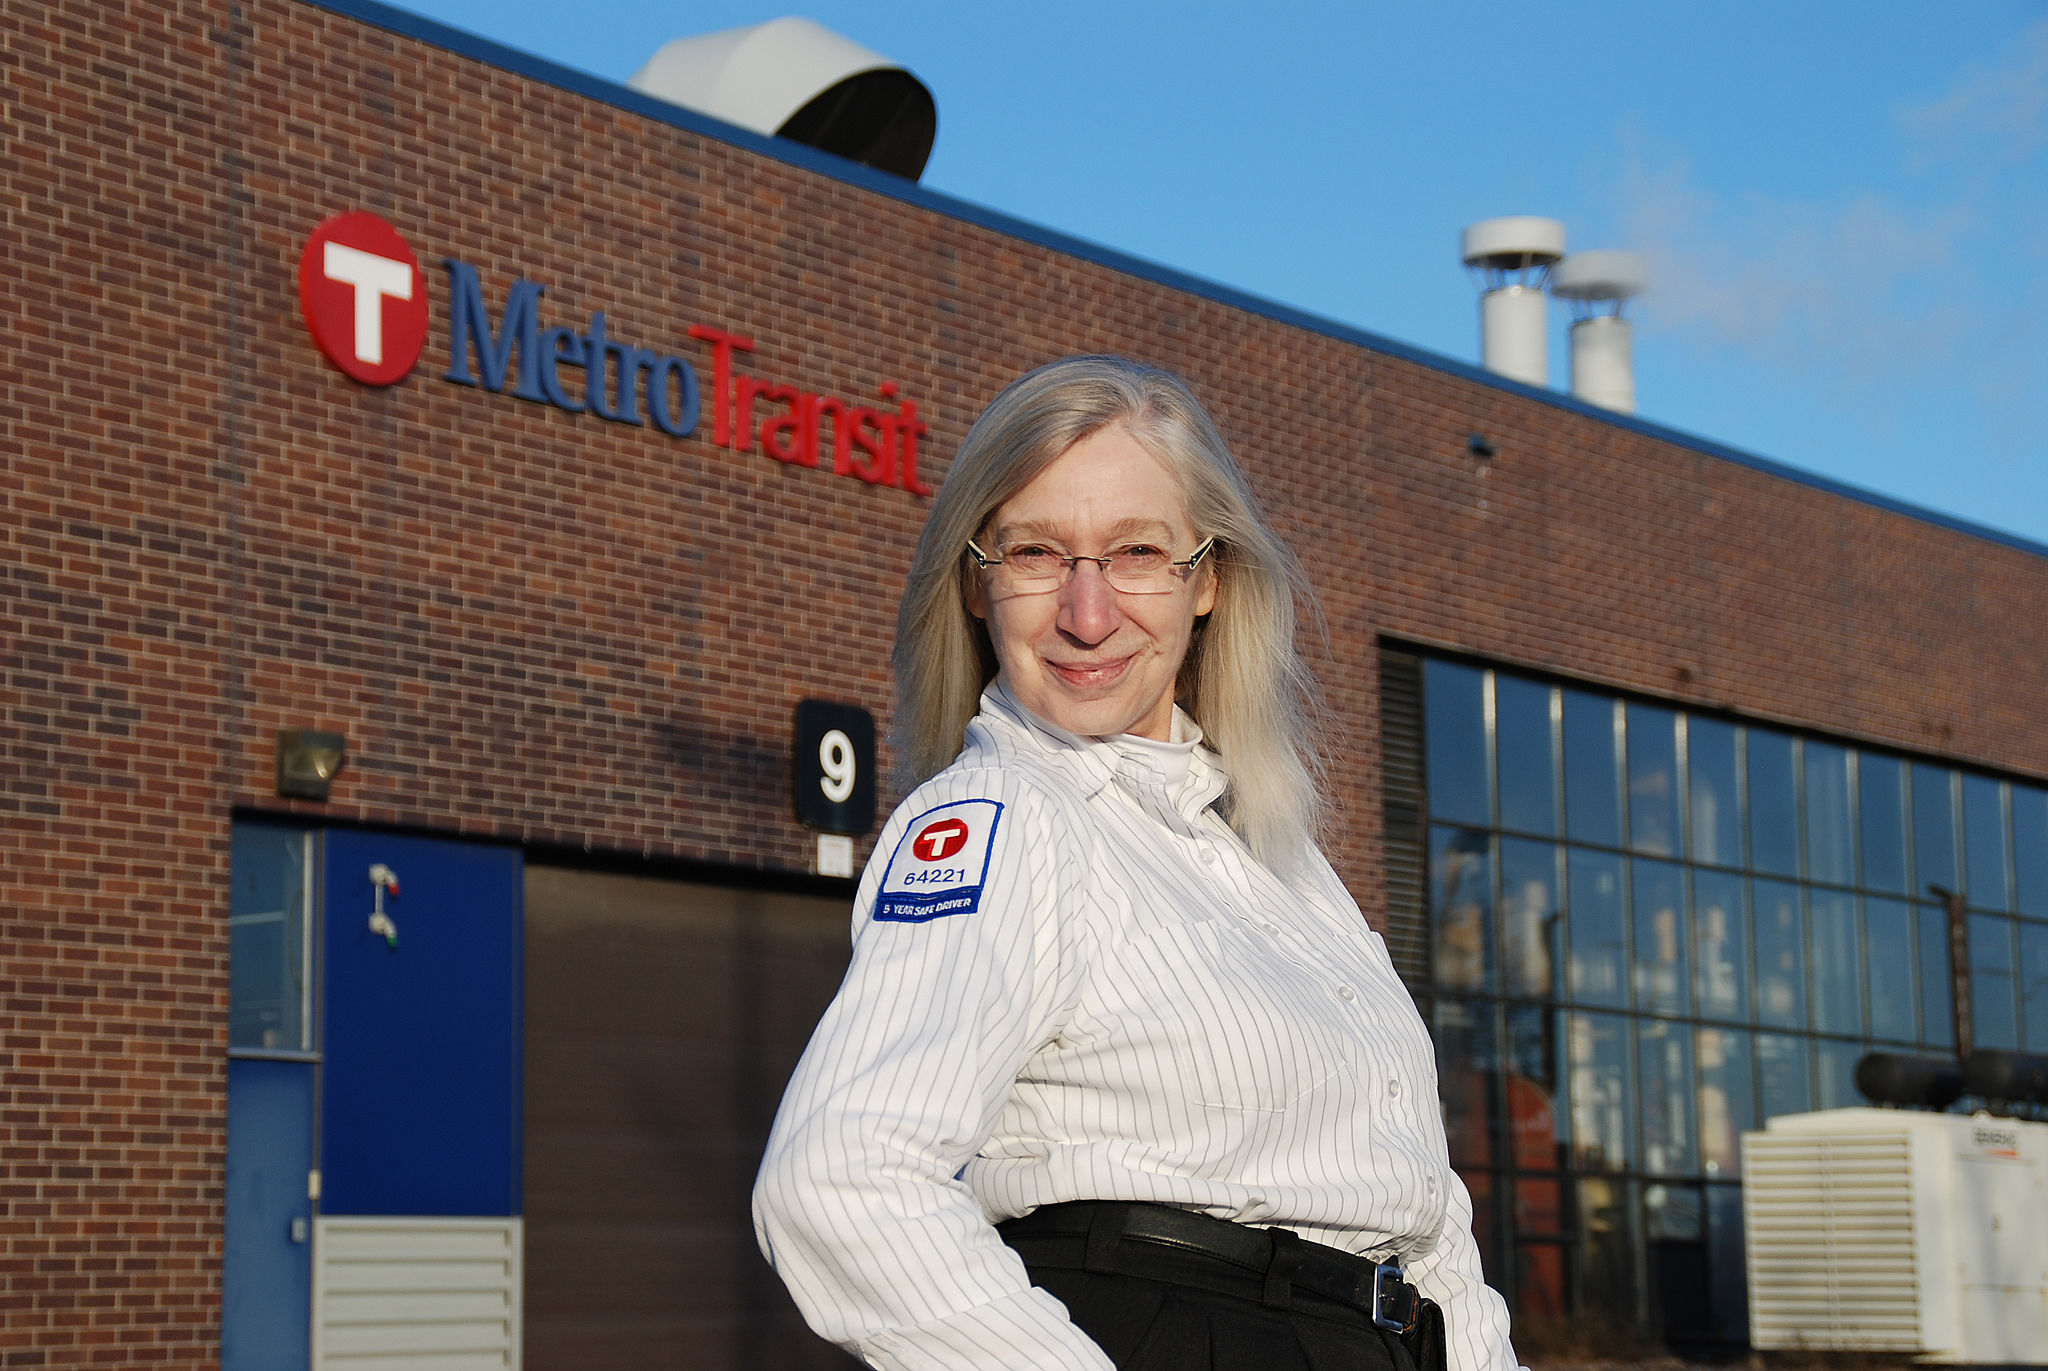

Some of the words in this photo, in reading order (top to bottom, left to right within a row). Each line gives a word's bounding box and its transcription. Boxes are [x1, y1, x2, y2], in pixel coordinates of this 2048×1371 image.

[323, 241, 412, 365] T
[819, 729, 856, 803] 9
[924, 829, 961, 857] T
[904, 869, 965, 885] 64221
[883, 904, 891, 914] 5
[893, 904, 914, 915] YEAR
[914, 904, 936, 916] SAFE
[935, 897, 972, 912] DRIVER
